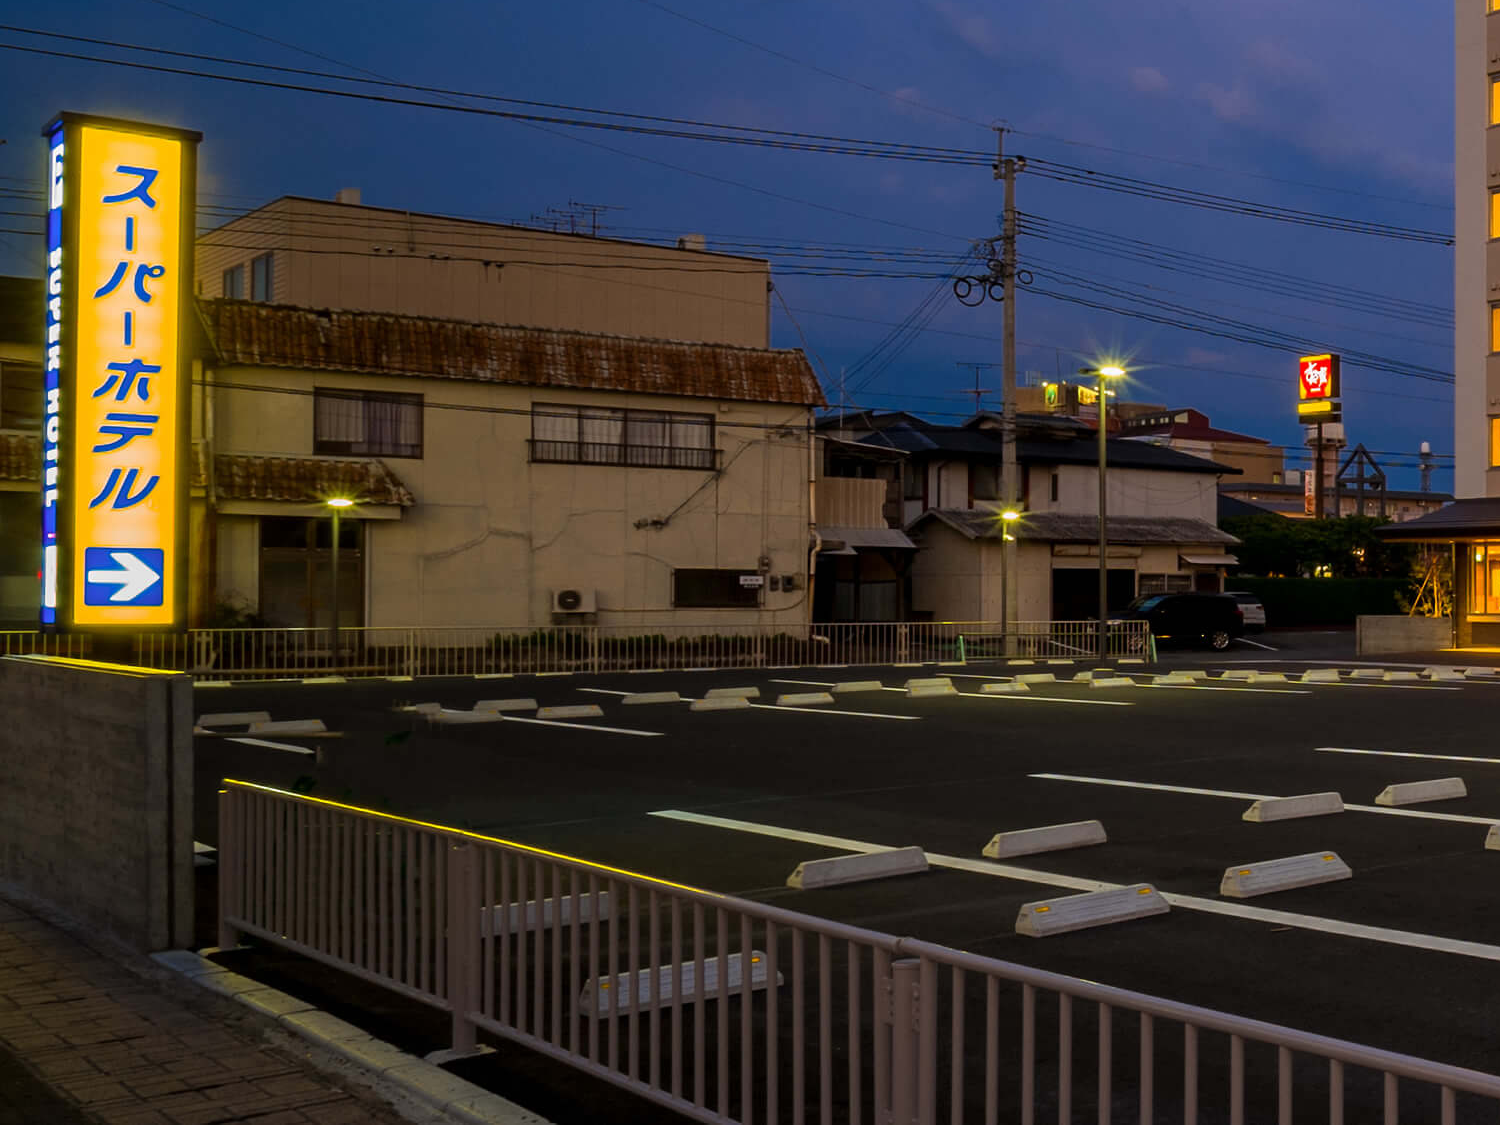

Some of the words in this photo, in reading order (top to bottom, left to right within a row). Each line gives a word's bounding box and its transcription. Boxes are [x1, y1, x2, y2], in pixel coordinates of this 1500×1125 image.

[88, 164, 166, 510] スーパーホテル
